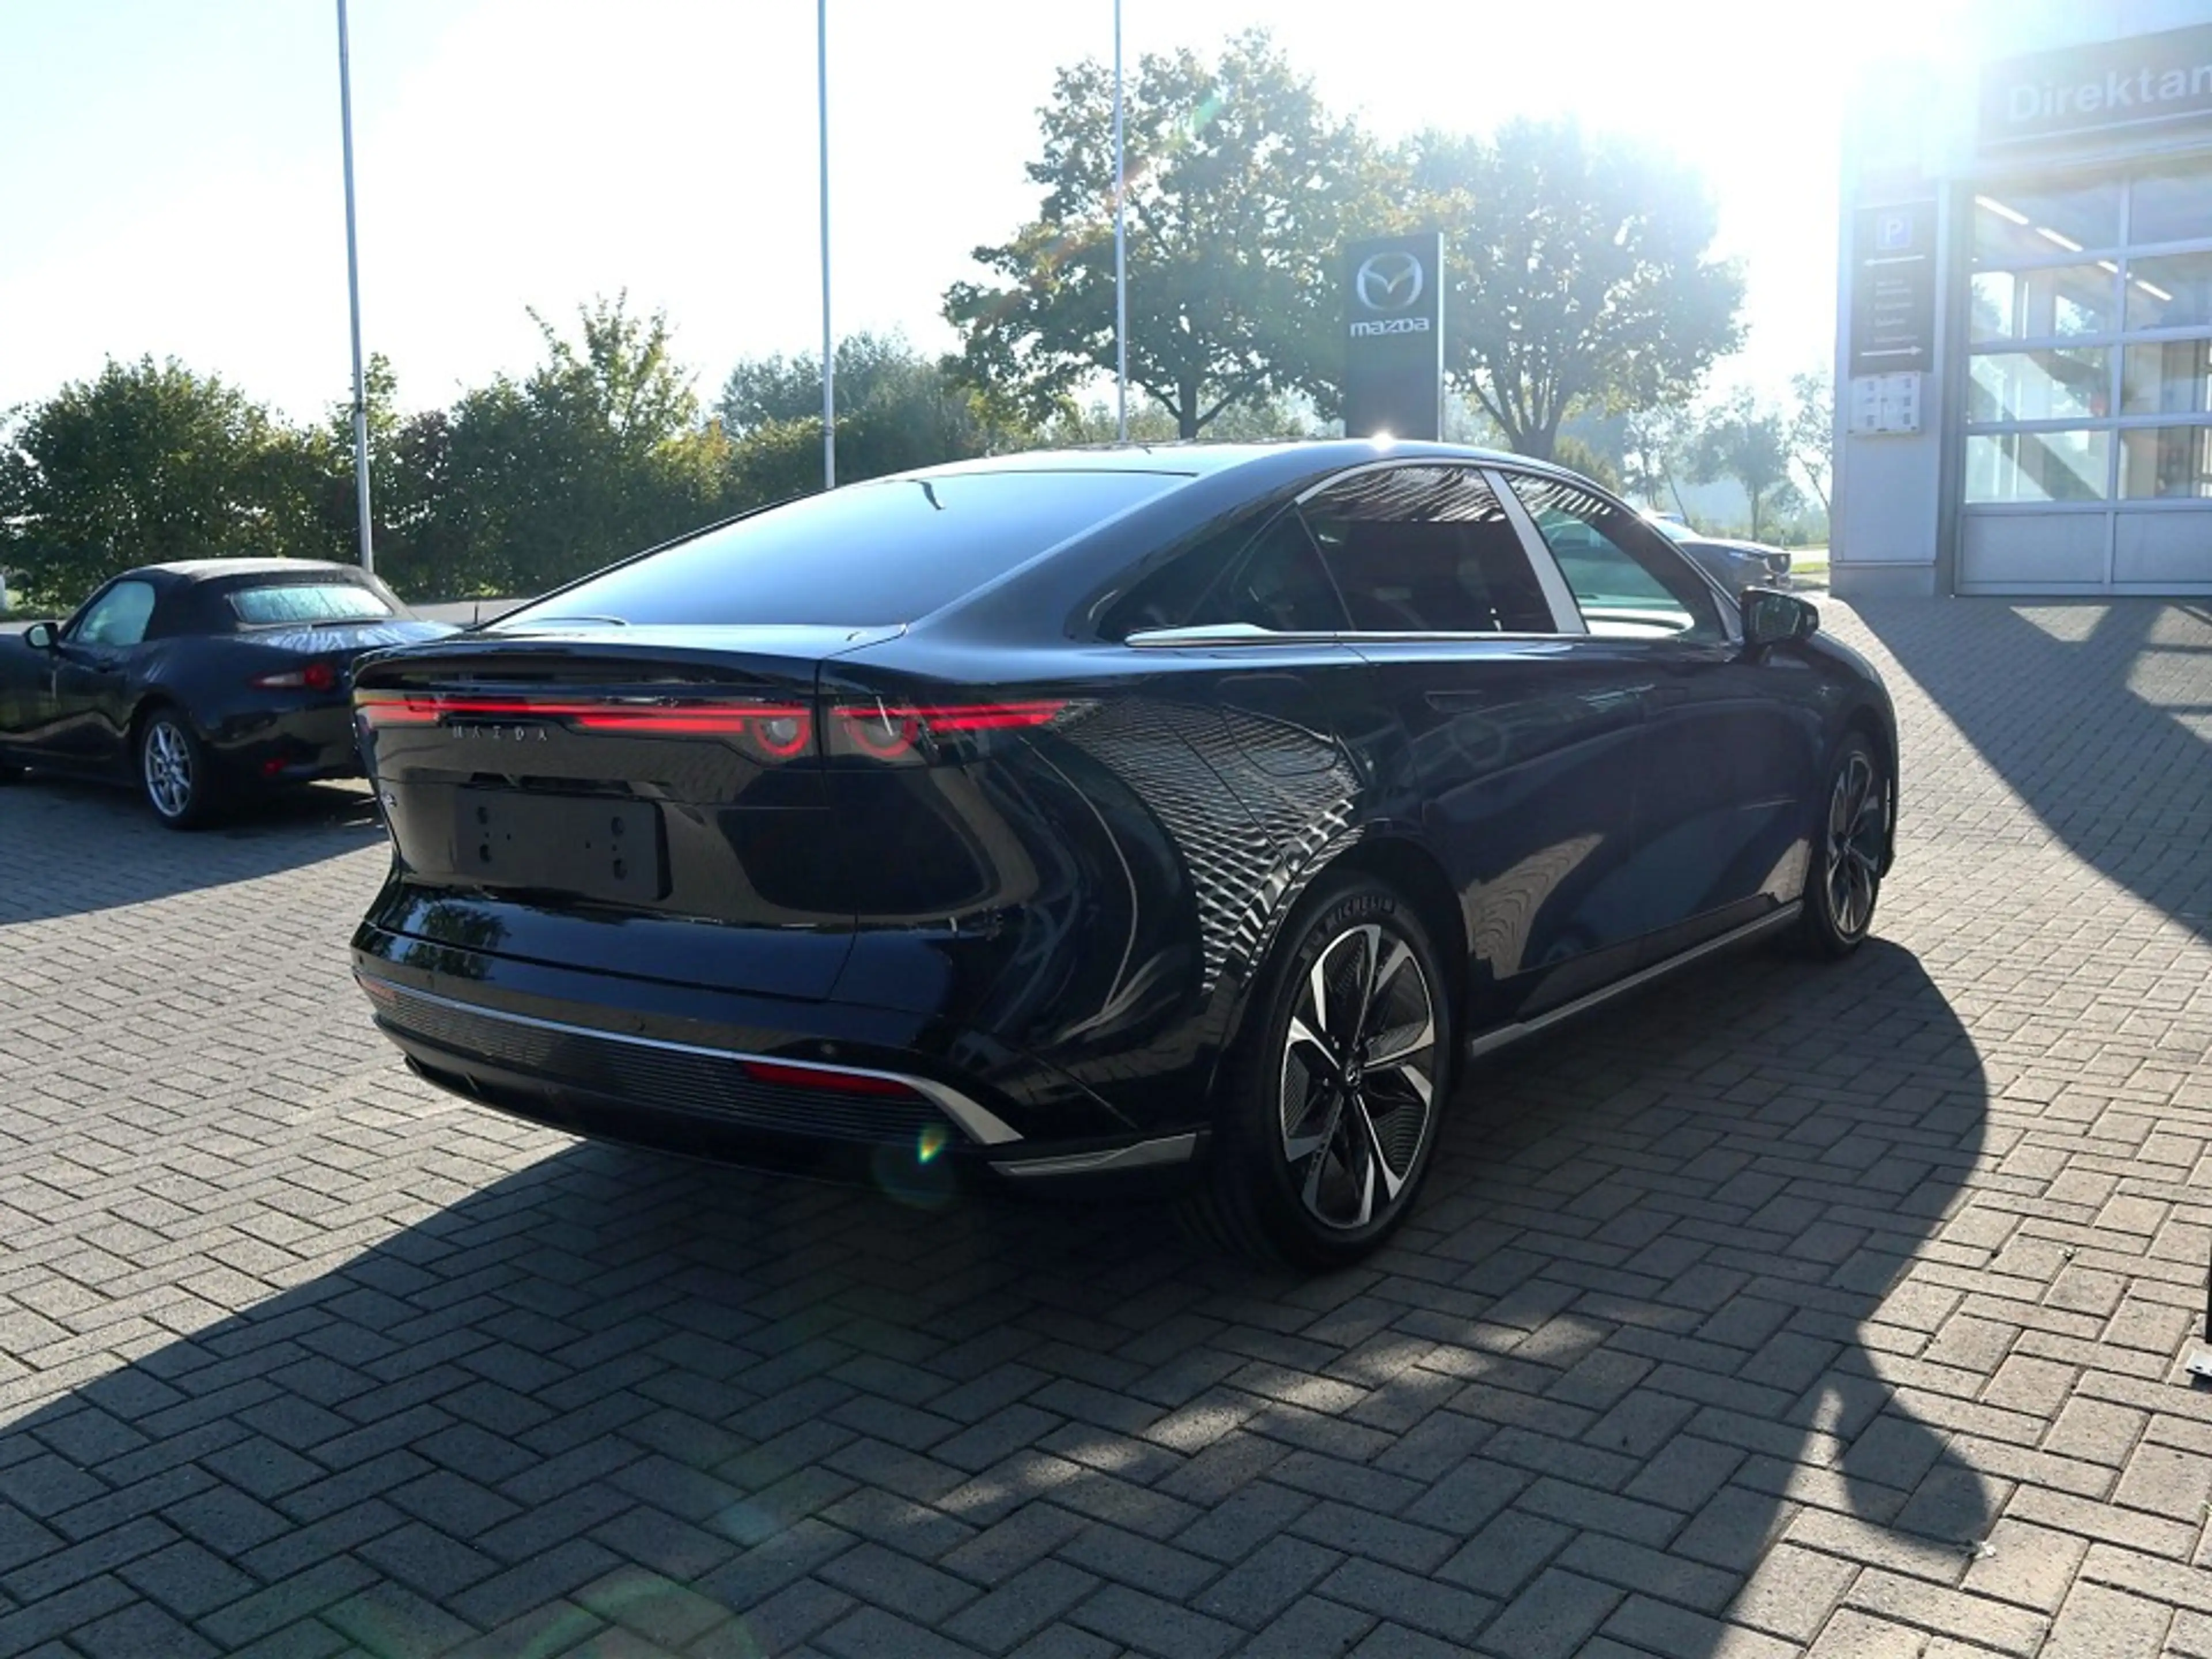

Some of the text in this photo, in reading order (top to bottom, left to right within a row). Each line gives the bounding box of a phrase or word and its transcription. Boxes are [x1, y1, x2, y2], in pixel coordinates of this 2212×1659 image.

[1885, 218, 1904, 244] P
[1350, 317, 1430, 338] mazda
[452, 725, 548, 742] MAZDA
